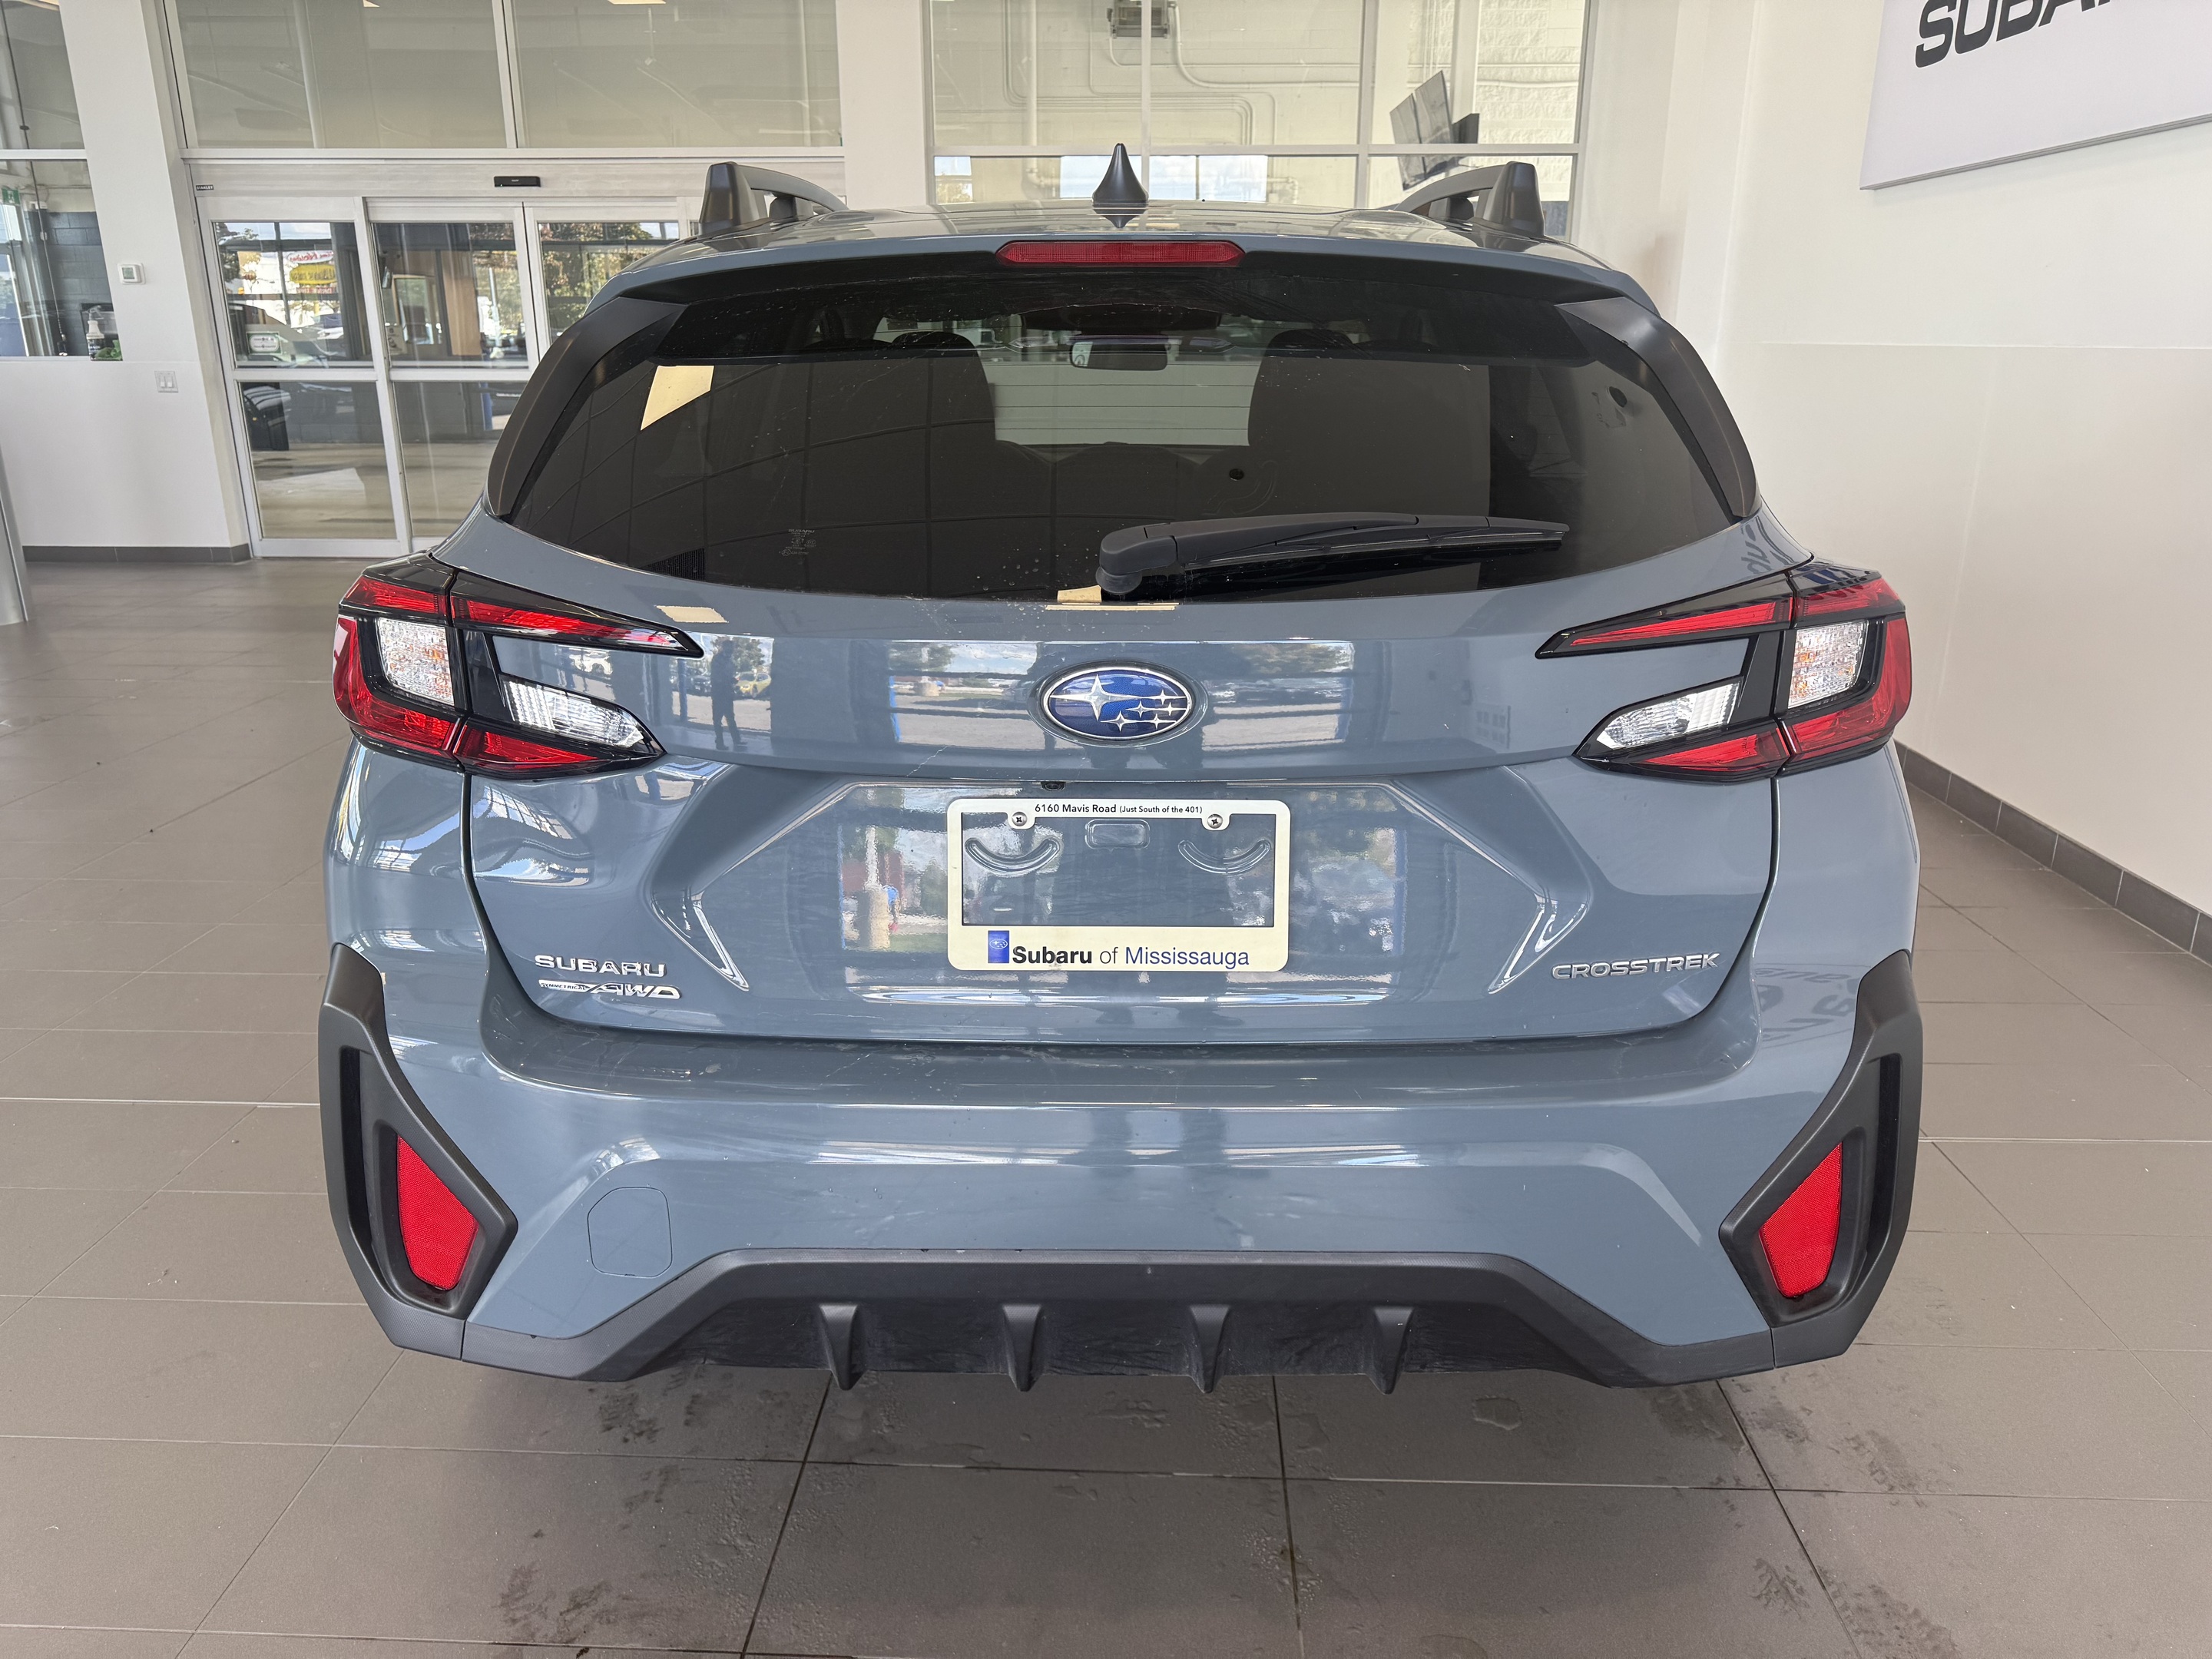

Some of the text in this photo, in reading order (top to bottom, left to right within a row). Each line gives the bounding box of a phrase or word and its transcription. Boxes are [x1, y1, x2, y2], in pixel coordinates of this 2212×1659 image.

[1035, 803, 1059, 813] 6160
[1062, 803, 1089, 813] Mavis
[1092, 803, 1116, 813] Road
[1119, 806, 1137, 814] (Just
[1138, 805, 1160, 813] South
[1161, 805, 1170, 813] of
[1185, 806, 1202, 814] 401)
[535, 955, 665, 978] SUBARU
[1012, 945, 1250, 969] Subaru of Mississauga
[1551, 952, 1720, 979] CROSSTREK
[540, 982, 681, 1000] SYMMETRICAL AWD
